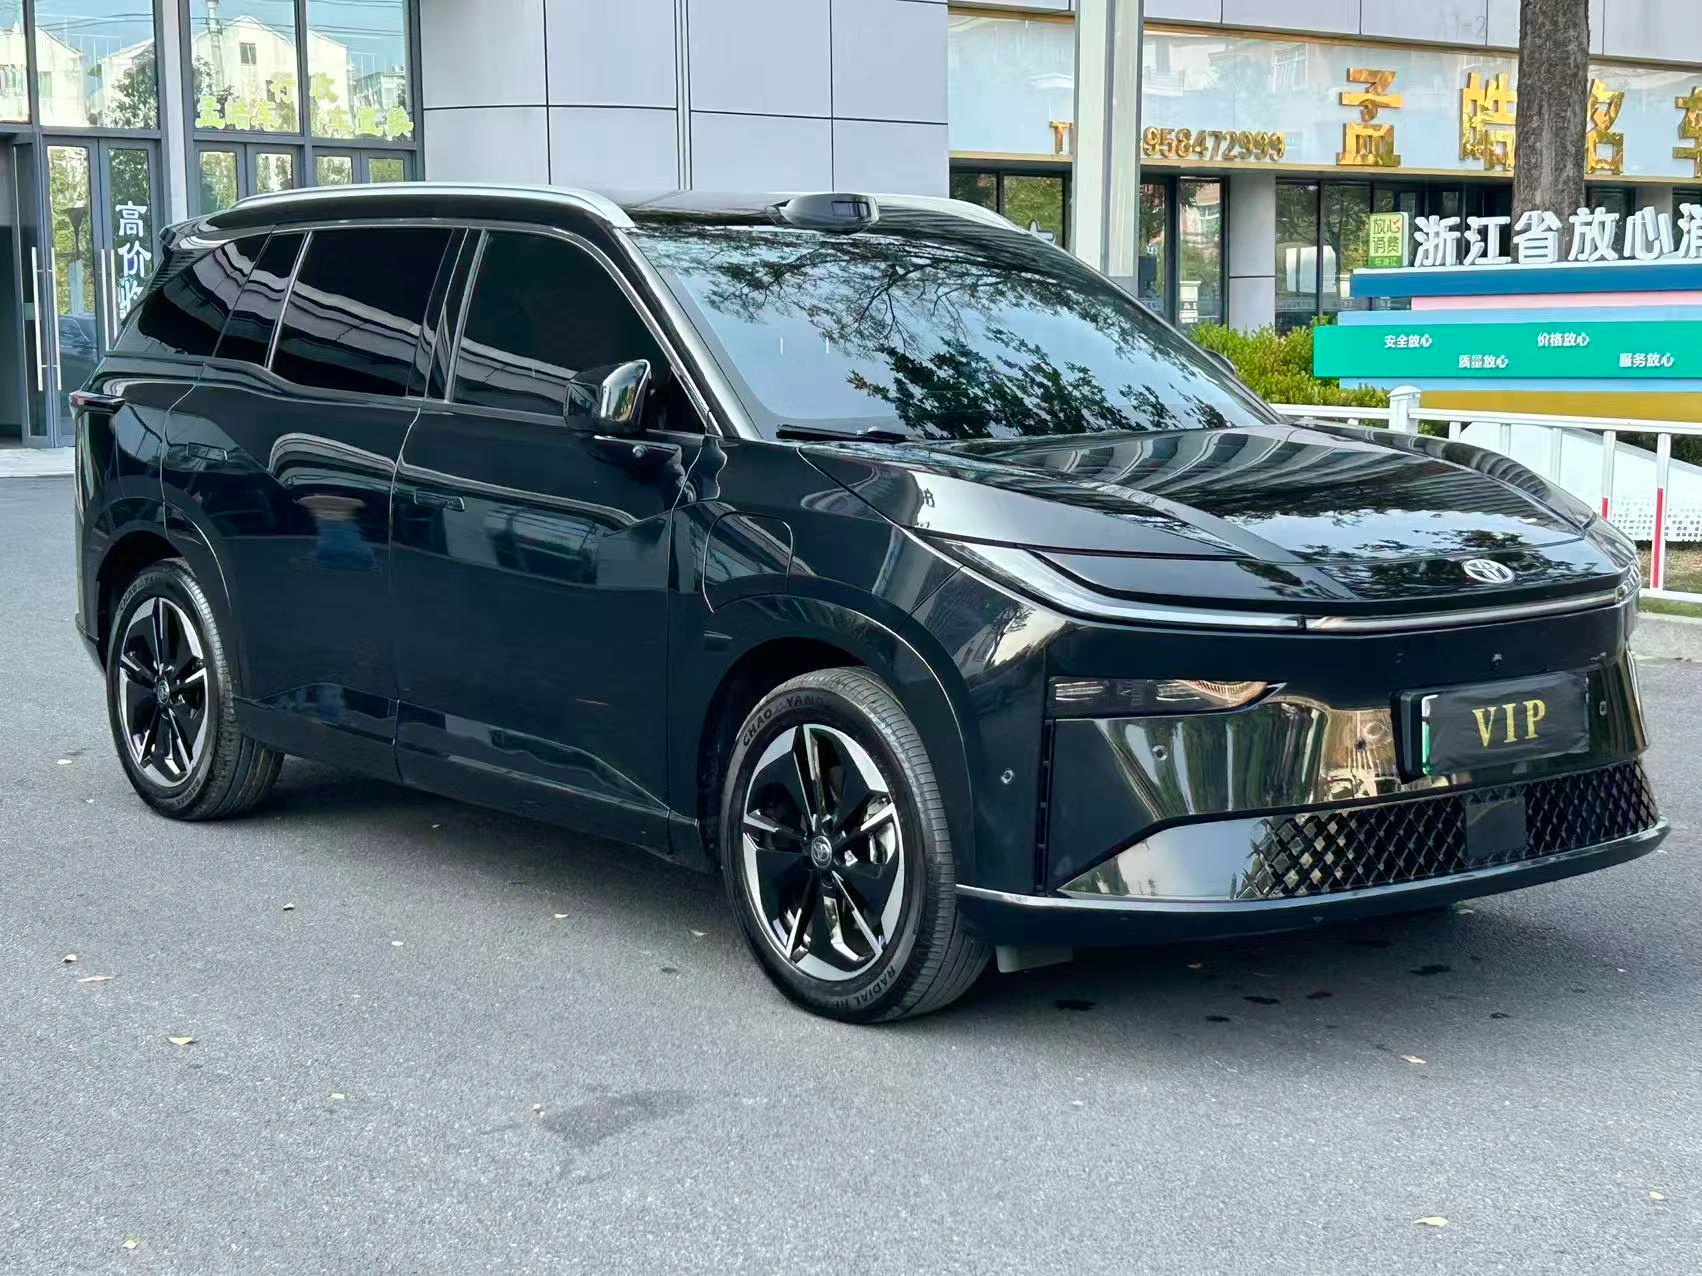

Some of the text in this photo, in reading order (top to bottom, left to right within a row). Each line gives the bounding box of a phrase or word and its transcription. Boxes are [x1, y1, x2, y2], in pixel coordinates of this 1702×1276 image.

[1140, 126, 1285, 161] 958472999
[1374, 218, 1401, 234] 放心
[1384, 334, 1433, 348] 安全放心
[1537, 332, 1591, 347] 价格放心
[1458, 354, 1509, 369] 质量放心
[1619, 352, 1675, 368] 服务放心
[743, 709, 773, 746] CHAO
[1472, 700, 1546, 746] VIP
[852, 966, 896, 1006] RADIAL
